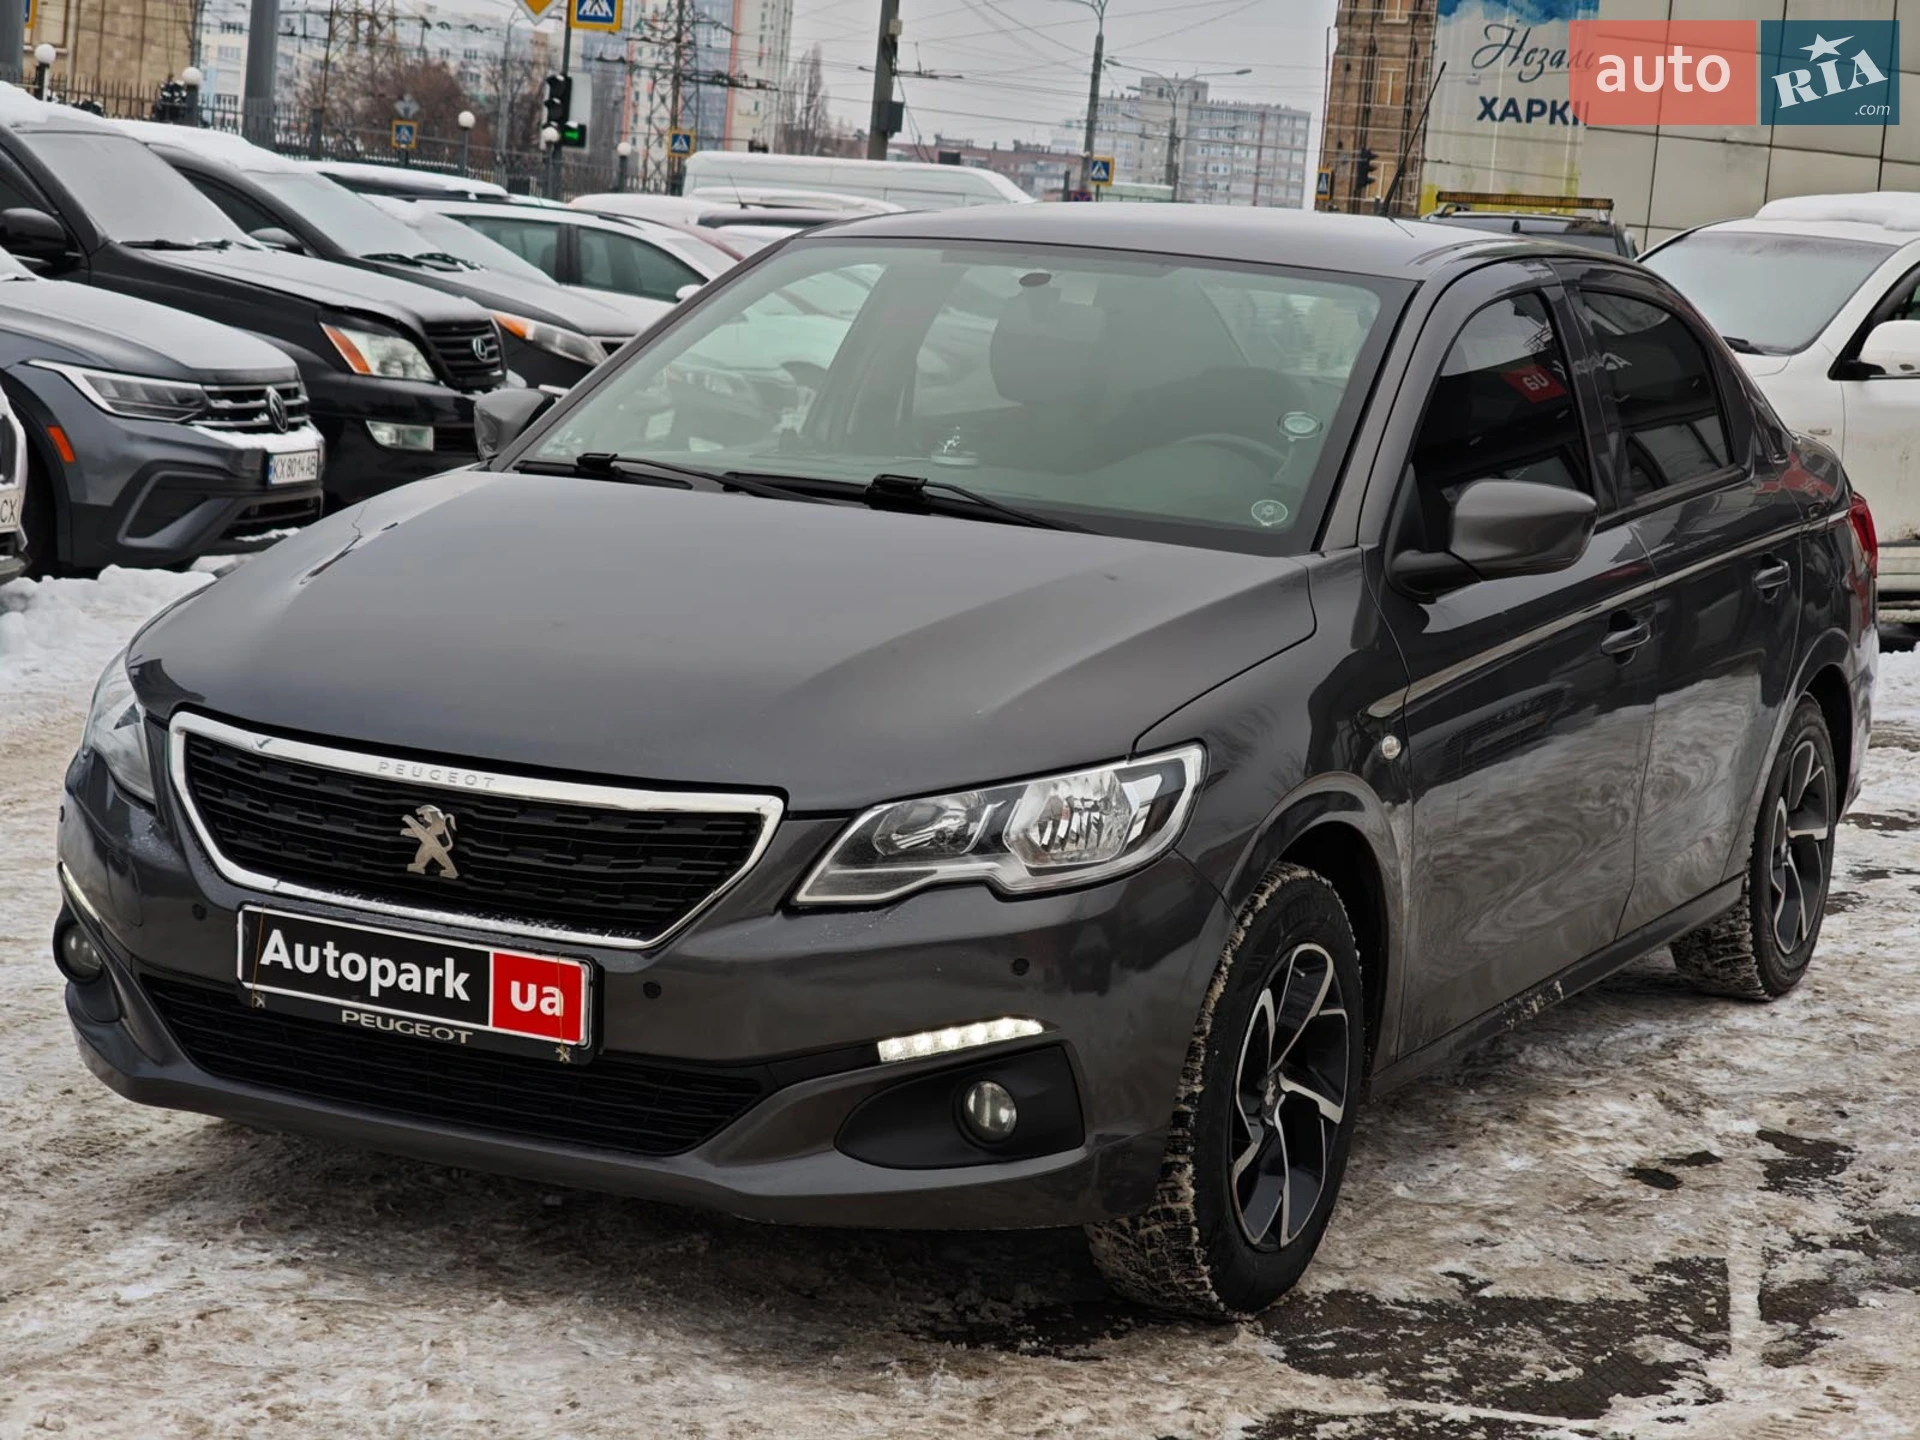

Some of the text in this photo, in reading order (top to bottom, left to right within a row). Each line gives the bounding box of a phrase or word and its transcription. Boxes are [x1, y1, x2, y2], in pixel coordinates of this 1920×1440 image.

[1477, 96, 1588, 126] ХАРКІ
[377, 761, 495, 789] PEUGEOT
[259, 928, 565, 1017] Autopark ua
[341, 1008, 474, 1044] PEUGEOT
